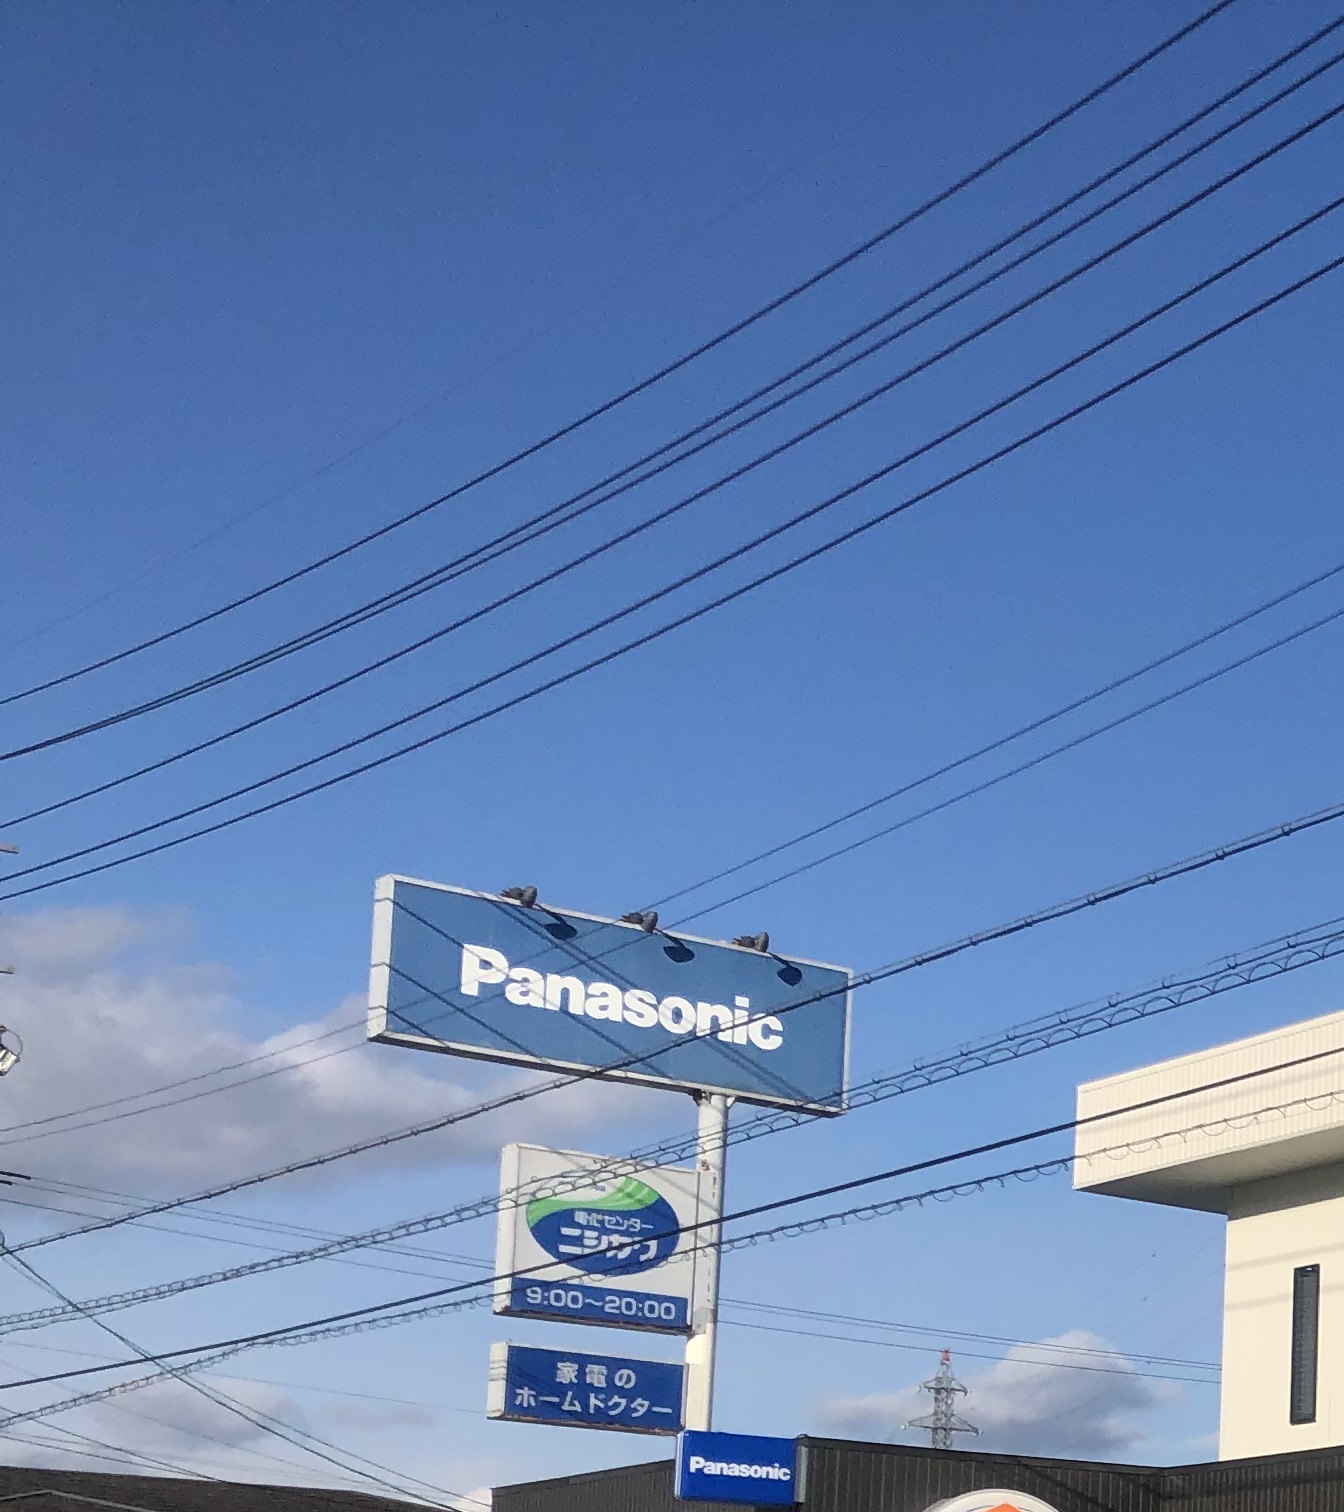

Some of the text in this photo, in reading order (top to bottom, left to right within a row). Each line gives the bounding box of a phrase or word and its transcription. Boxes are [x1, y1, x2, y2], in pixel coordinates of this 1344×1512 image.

[460, 943, 784, 1050] Panasonic
[558, 1226, 659, 1262] ニシカワ
[555, 1361, 637, 1389] 家電の
[515, 1386, 673, 1418] ホームドクター
[689, 1455, 792, 1482] Panasonic
